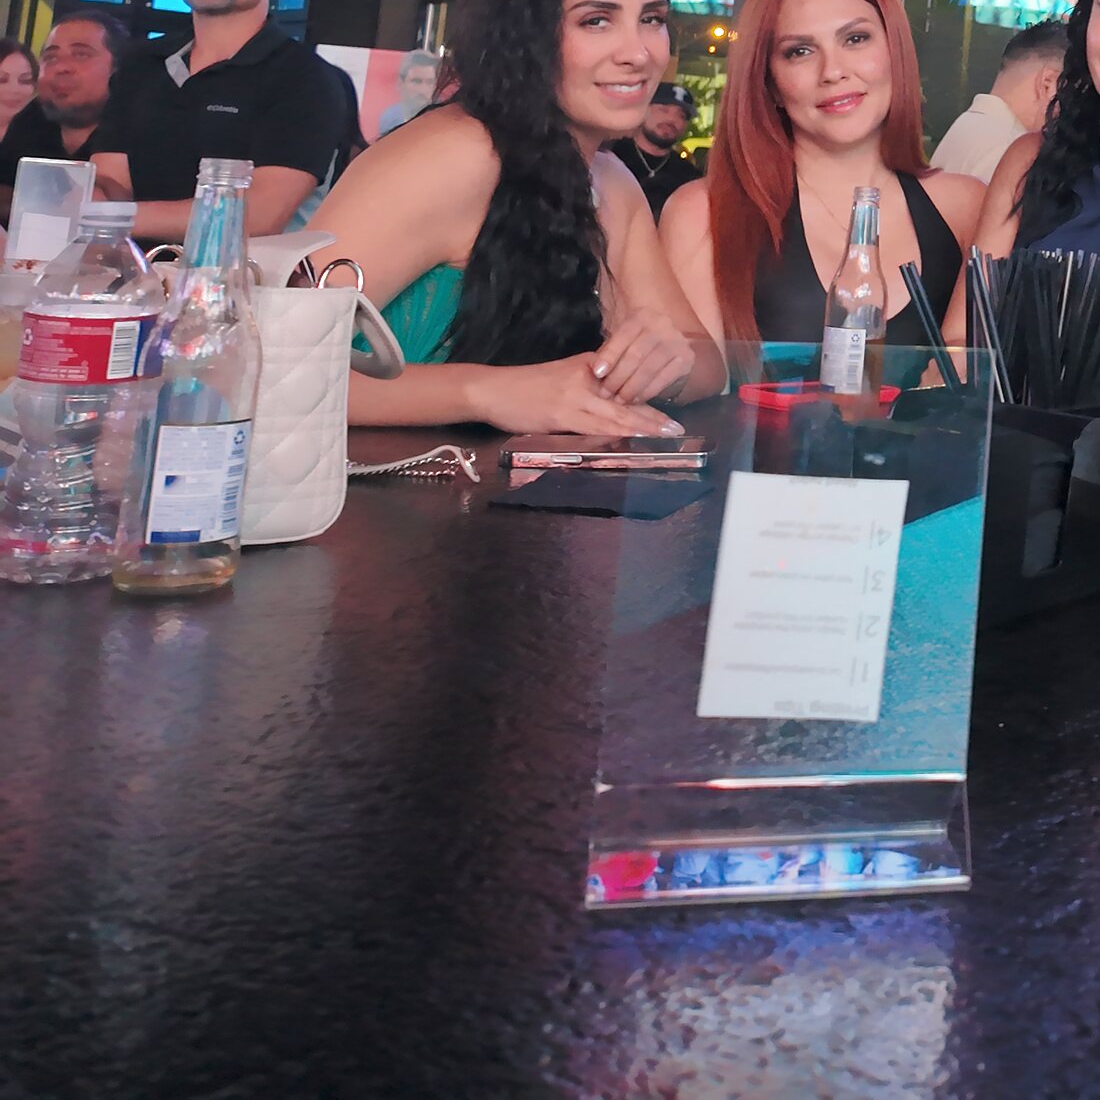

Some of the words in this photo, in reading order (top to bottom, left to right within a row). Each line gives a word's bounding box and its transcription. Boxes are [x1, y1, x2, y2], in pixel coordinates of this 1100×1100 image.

[877, 526, 893, 548] 4
[870, 569, 887, 593] 3
[864, 614, 881, 638] 2
